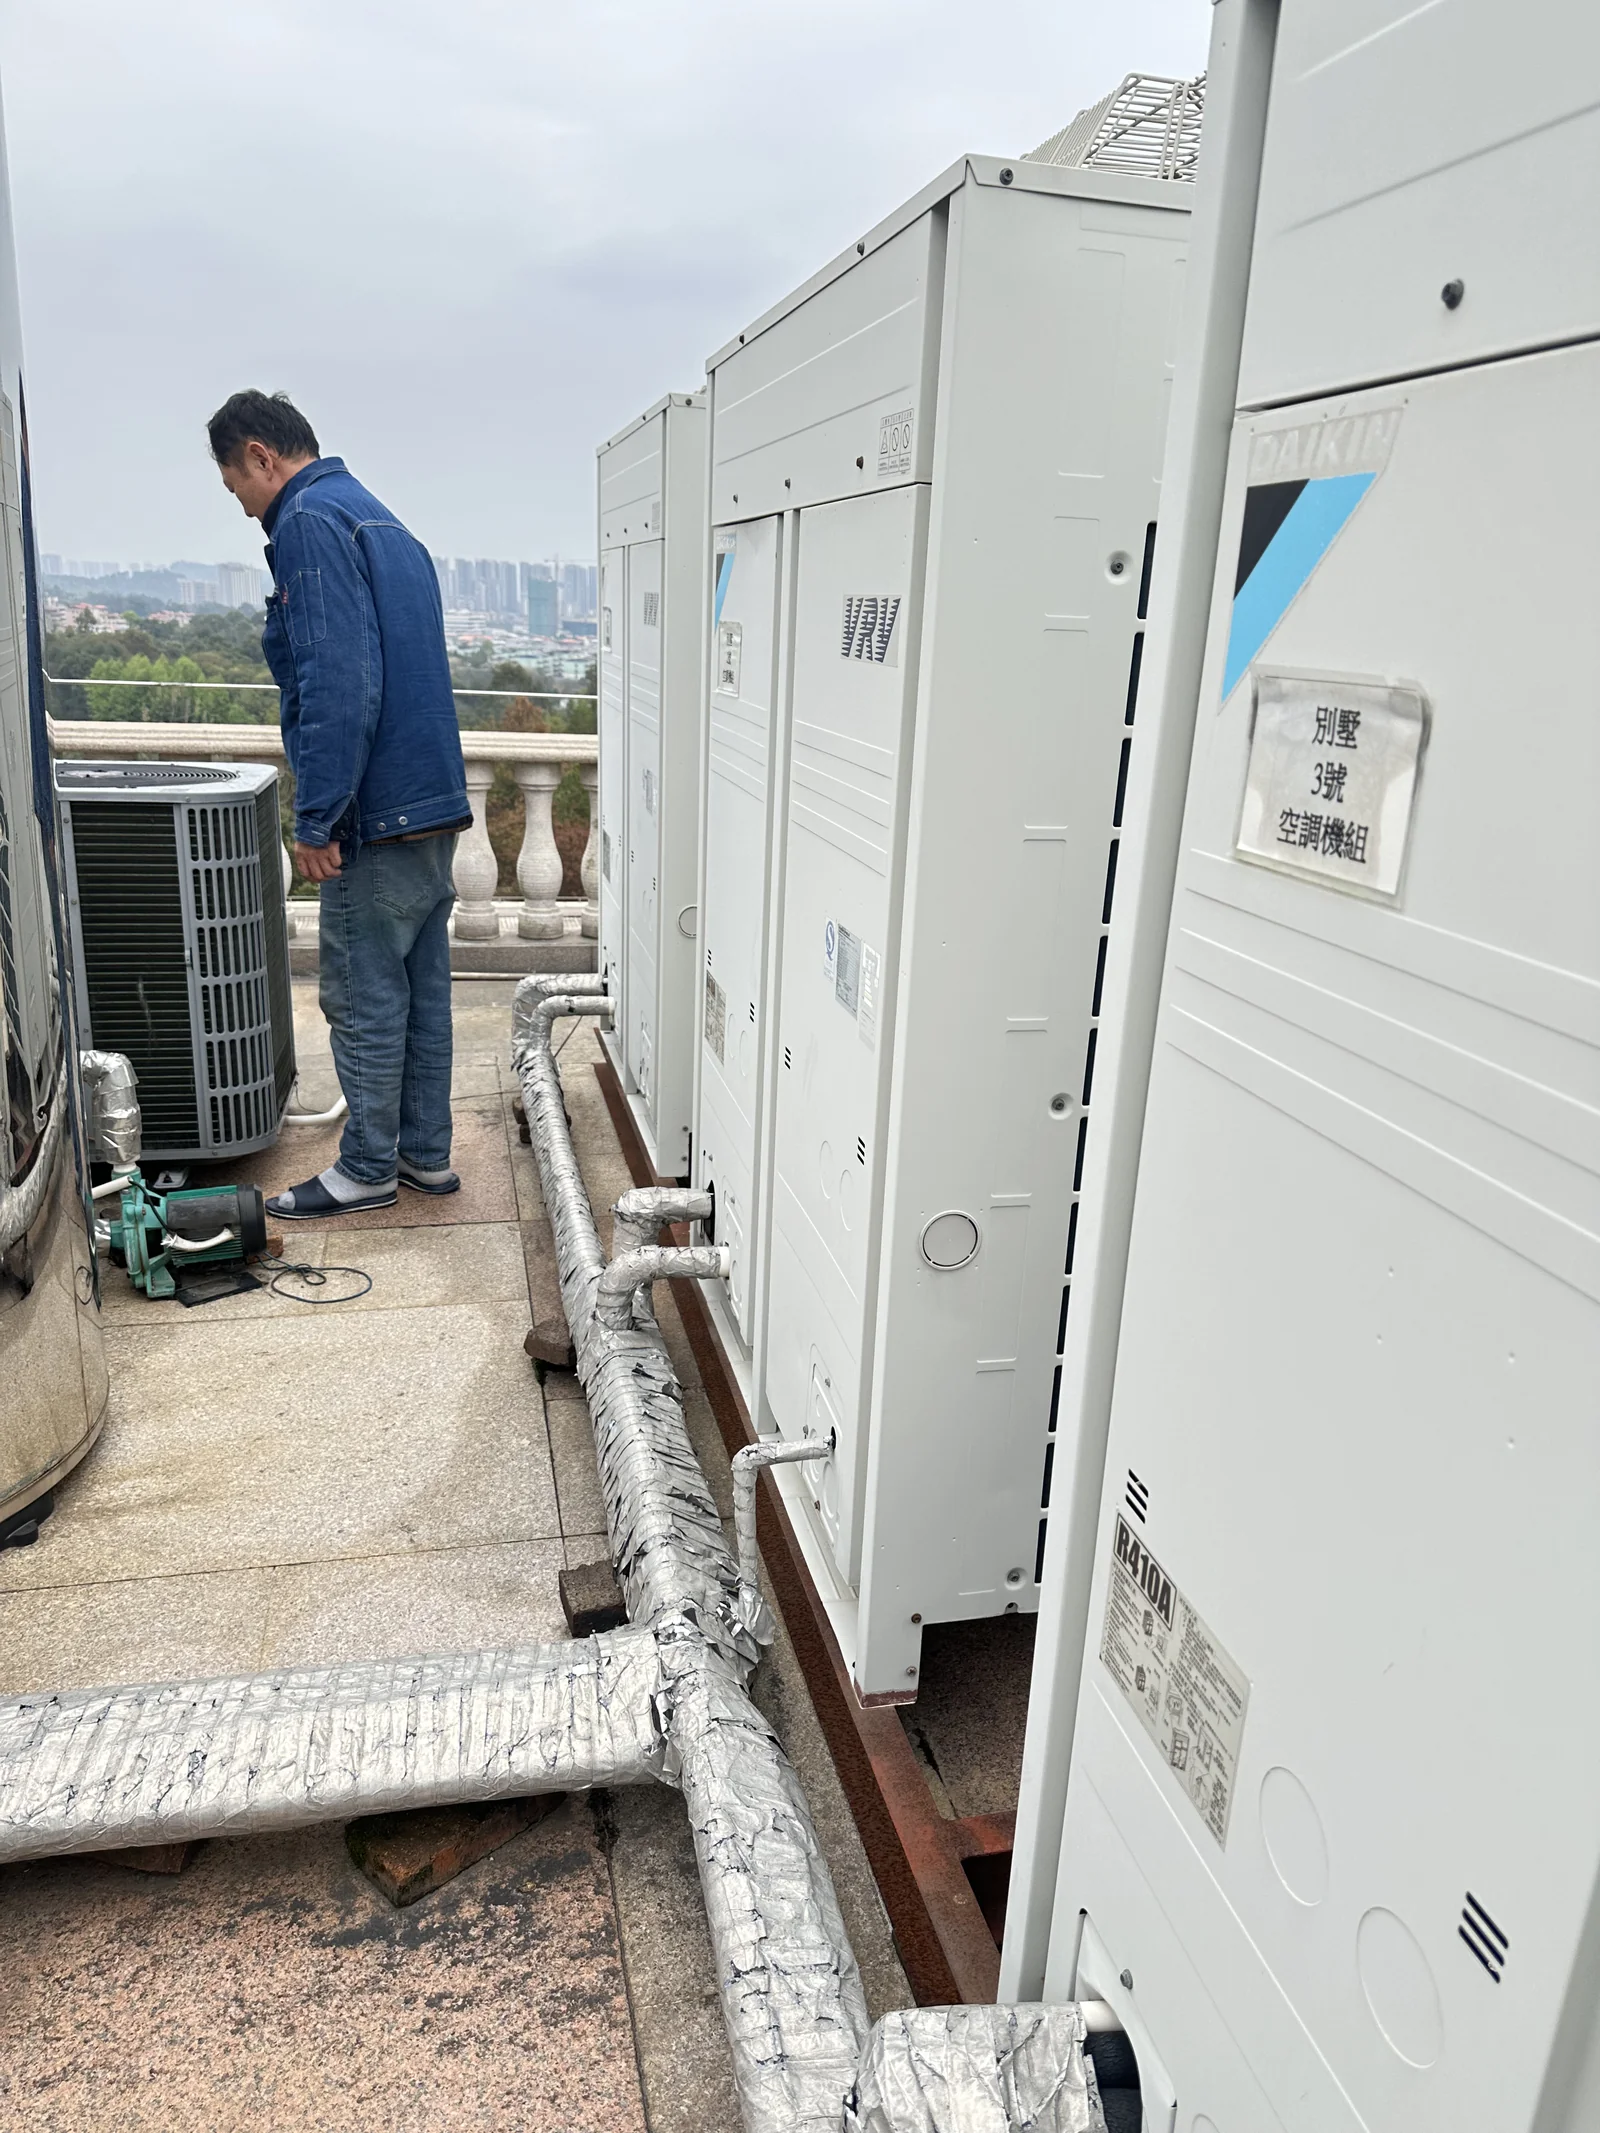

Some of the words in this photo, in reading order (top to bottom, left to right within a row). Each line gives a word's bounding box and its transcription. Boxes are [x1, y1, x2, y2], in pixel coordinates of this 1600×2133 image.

[841, 597, 901, 663] VRV
[1312, 706, 1361, 749] 別墅
[1311, 761, 1347, 803] 3號
[1276, 807, 1369, 864] 空調機組
[1117, 1521, 1171, 1624] R410A
